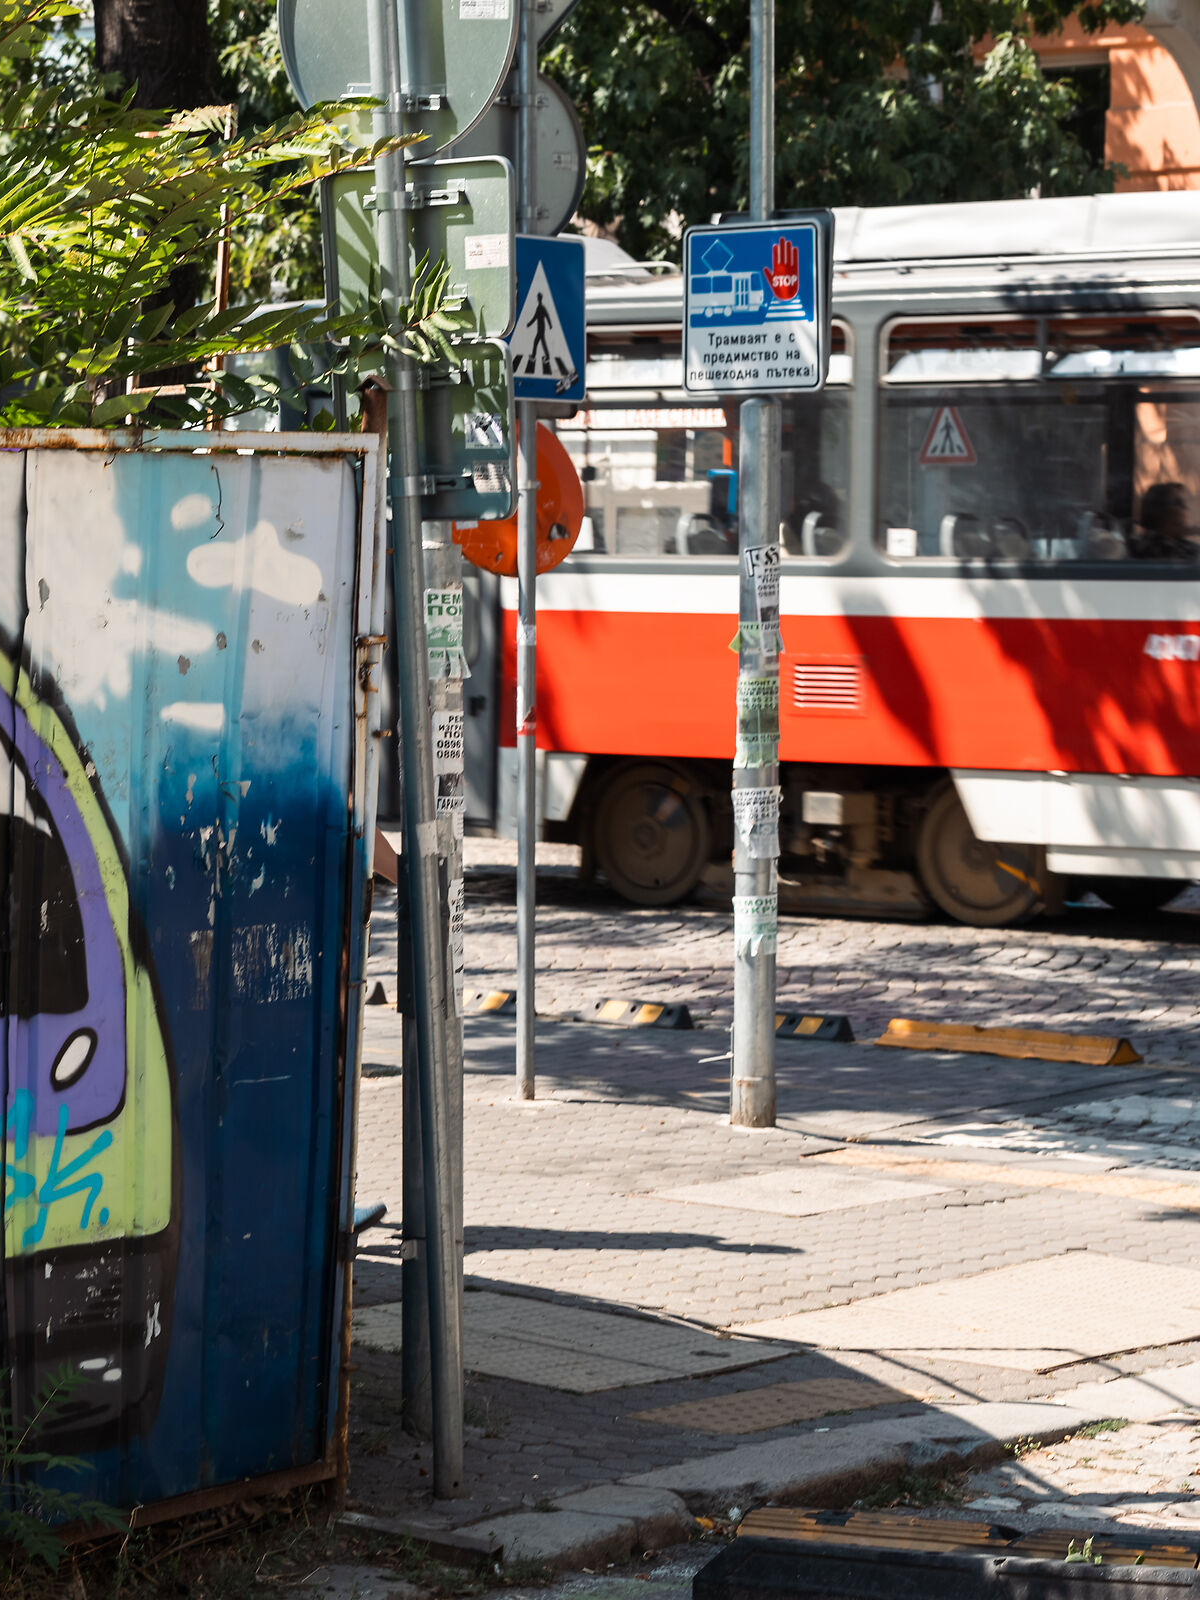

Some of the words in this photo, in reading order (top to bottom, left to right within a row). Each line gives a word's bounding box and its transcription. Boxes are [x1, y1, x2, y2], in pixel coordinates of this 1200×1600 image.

[772, 274, 798, 287] STOP
[708, 332, 768, 348] Трамваят
[774, 334, 781, 343] е
[788, 332, 796, 342] с
[703, 350, 779, 365] предимство
[786, 349, 801, 360] на
[690, 368, 759, 380] пешеходна
[766, 364, 815, 378] пътека!
